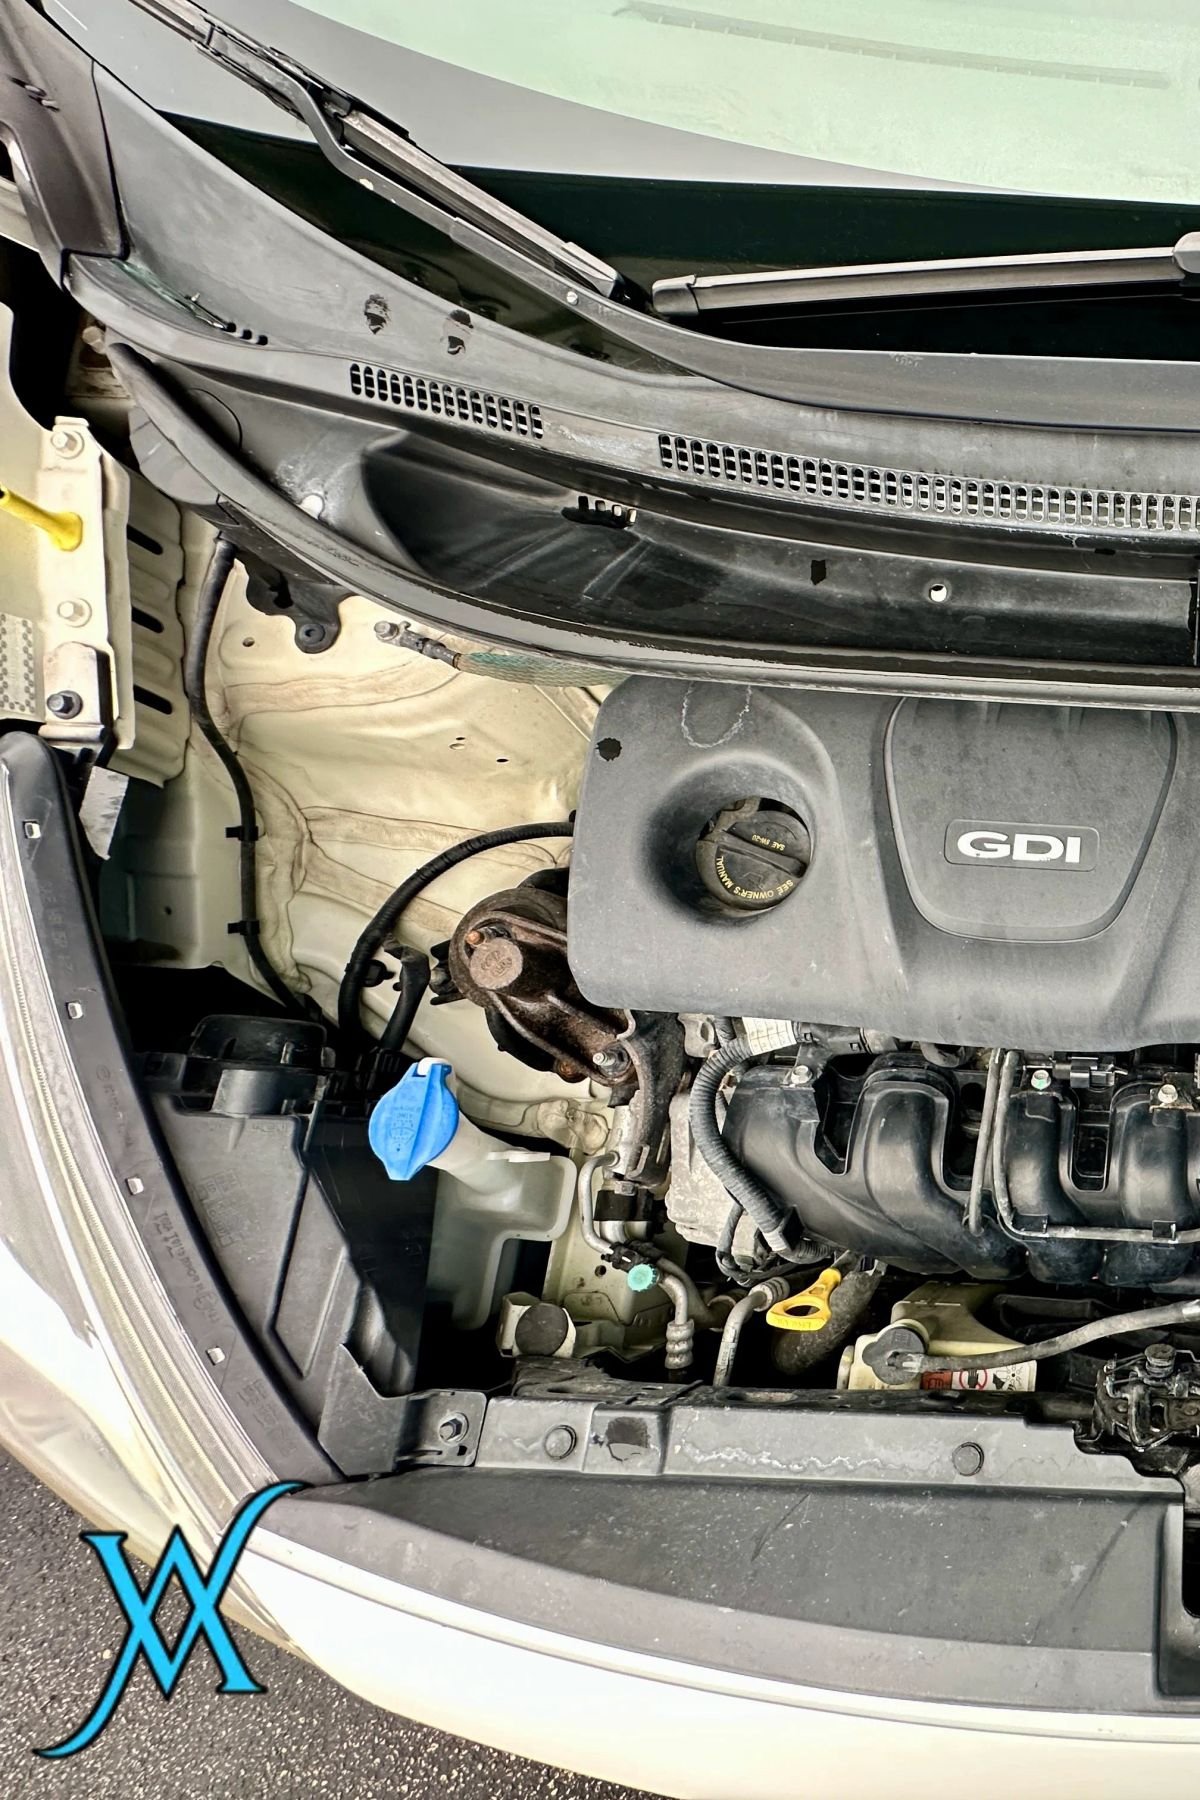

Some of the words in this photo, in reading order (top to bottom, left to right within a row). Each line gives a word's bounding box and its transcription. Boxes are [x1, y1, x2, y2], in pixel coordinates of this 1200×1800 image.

[771, 841, 786, 851] SAE
[957, 830, 1081, 853] GDI
[715, 856, 734, 889] MANUAL
[733, 885, 774, 900] OWNER'S
[776, 879, 794, 896] SEE
